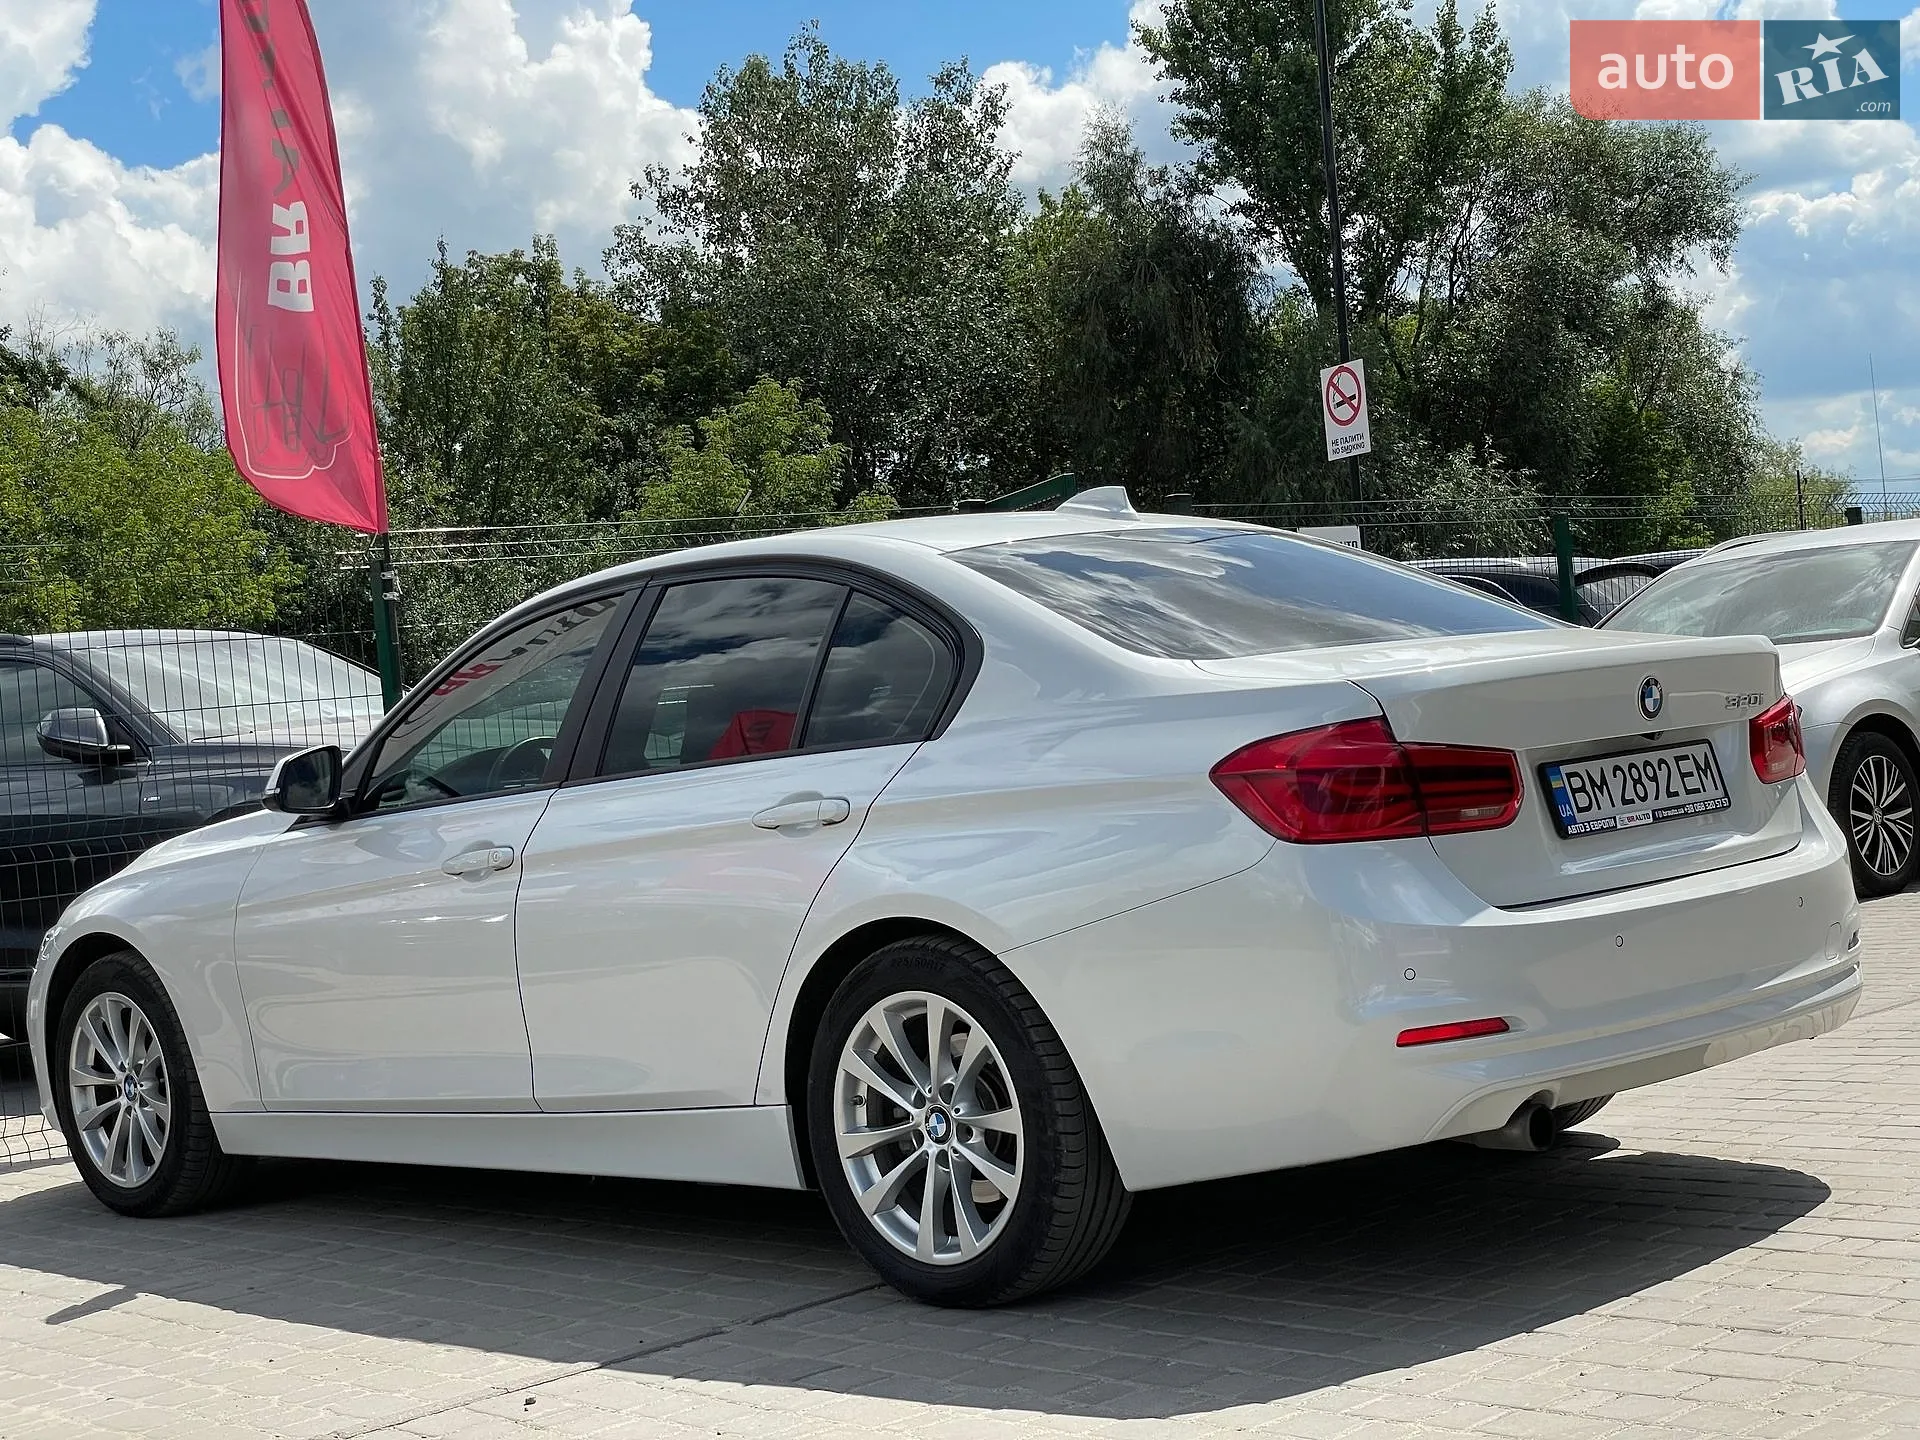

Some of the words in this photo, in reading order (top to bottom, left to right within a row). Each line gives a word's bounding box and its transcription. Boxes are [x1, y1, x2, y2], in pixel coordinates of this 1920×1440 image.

[1331, 438, 1340, 448] НЕ
[1340, 433, 1364, 445] ПАЛИТИ
[1332, 447, 1341, 455] NO
[1341, 442, 1365, 454] SMOKING
[1725, 692, 1763, 710] 320i
[1565, 767, 1615, 814] BM
[1613, 758, 1680, 806] 2892
[1673, 751, 1719, 796] EM
[1558, 804, 1574, 818] UA
[1568, 823, 1585, 835] АВТО
